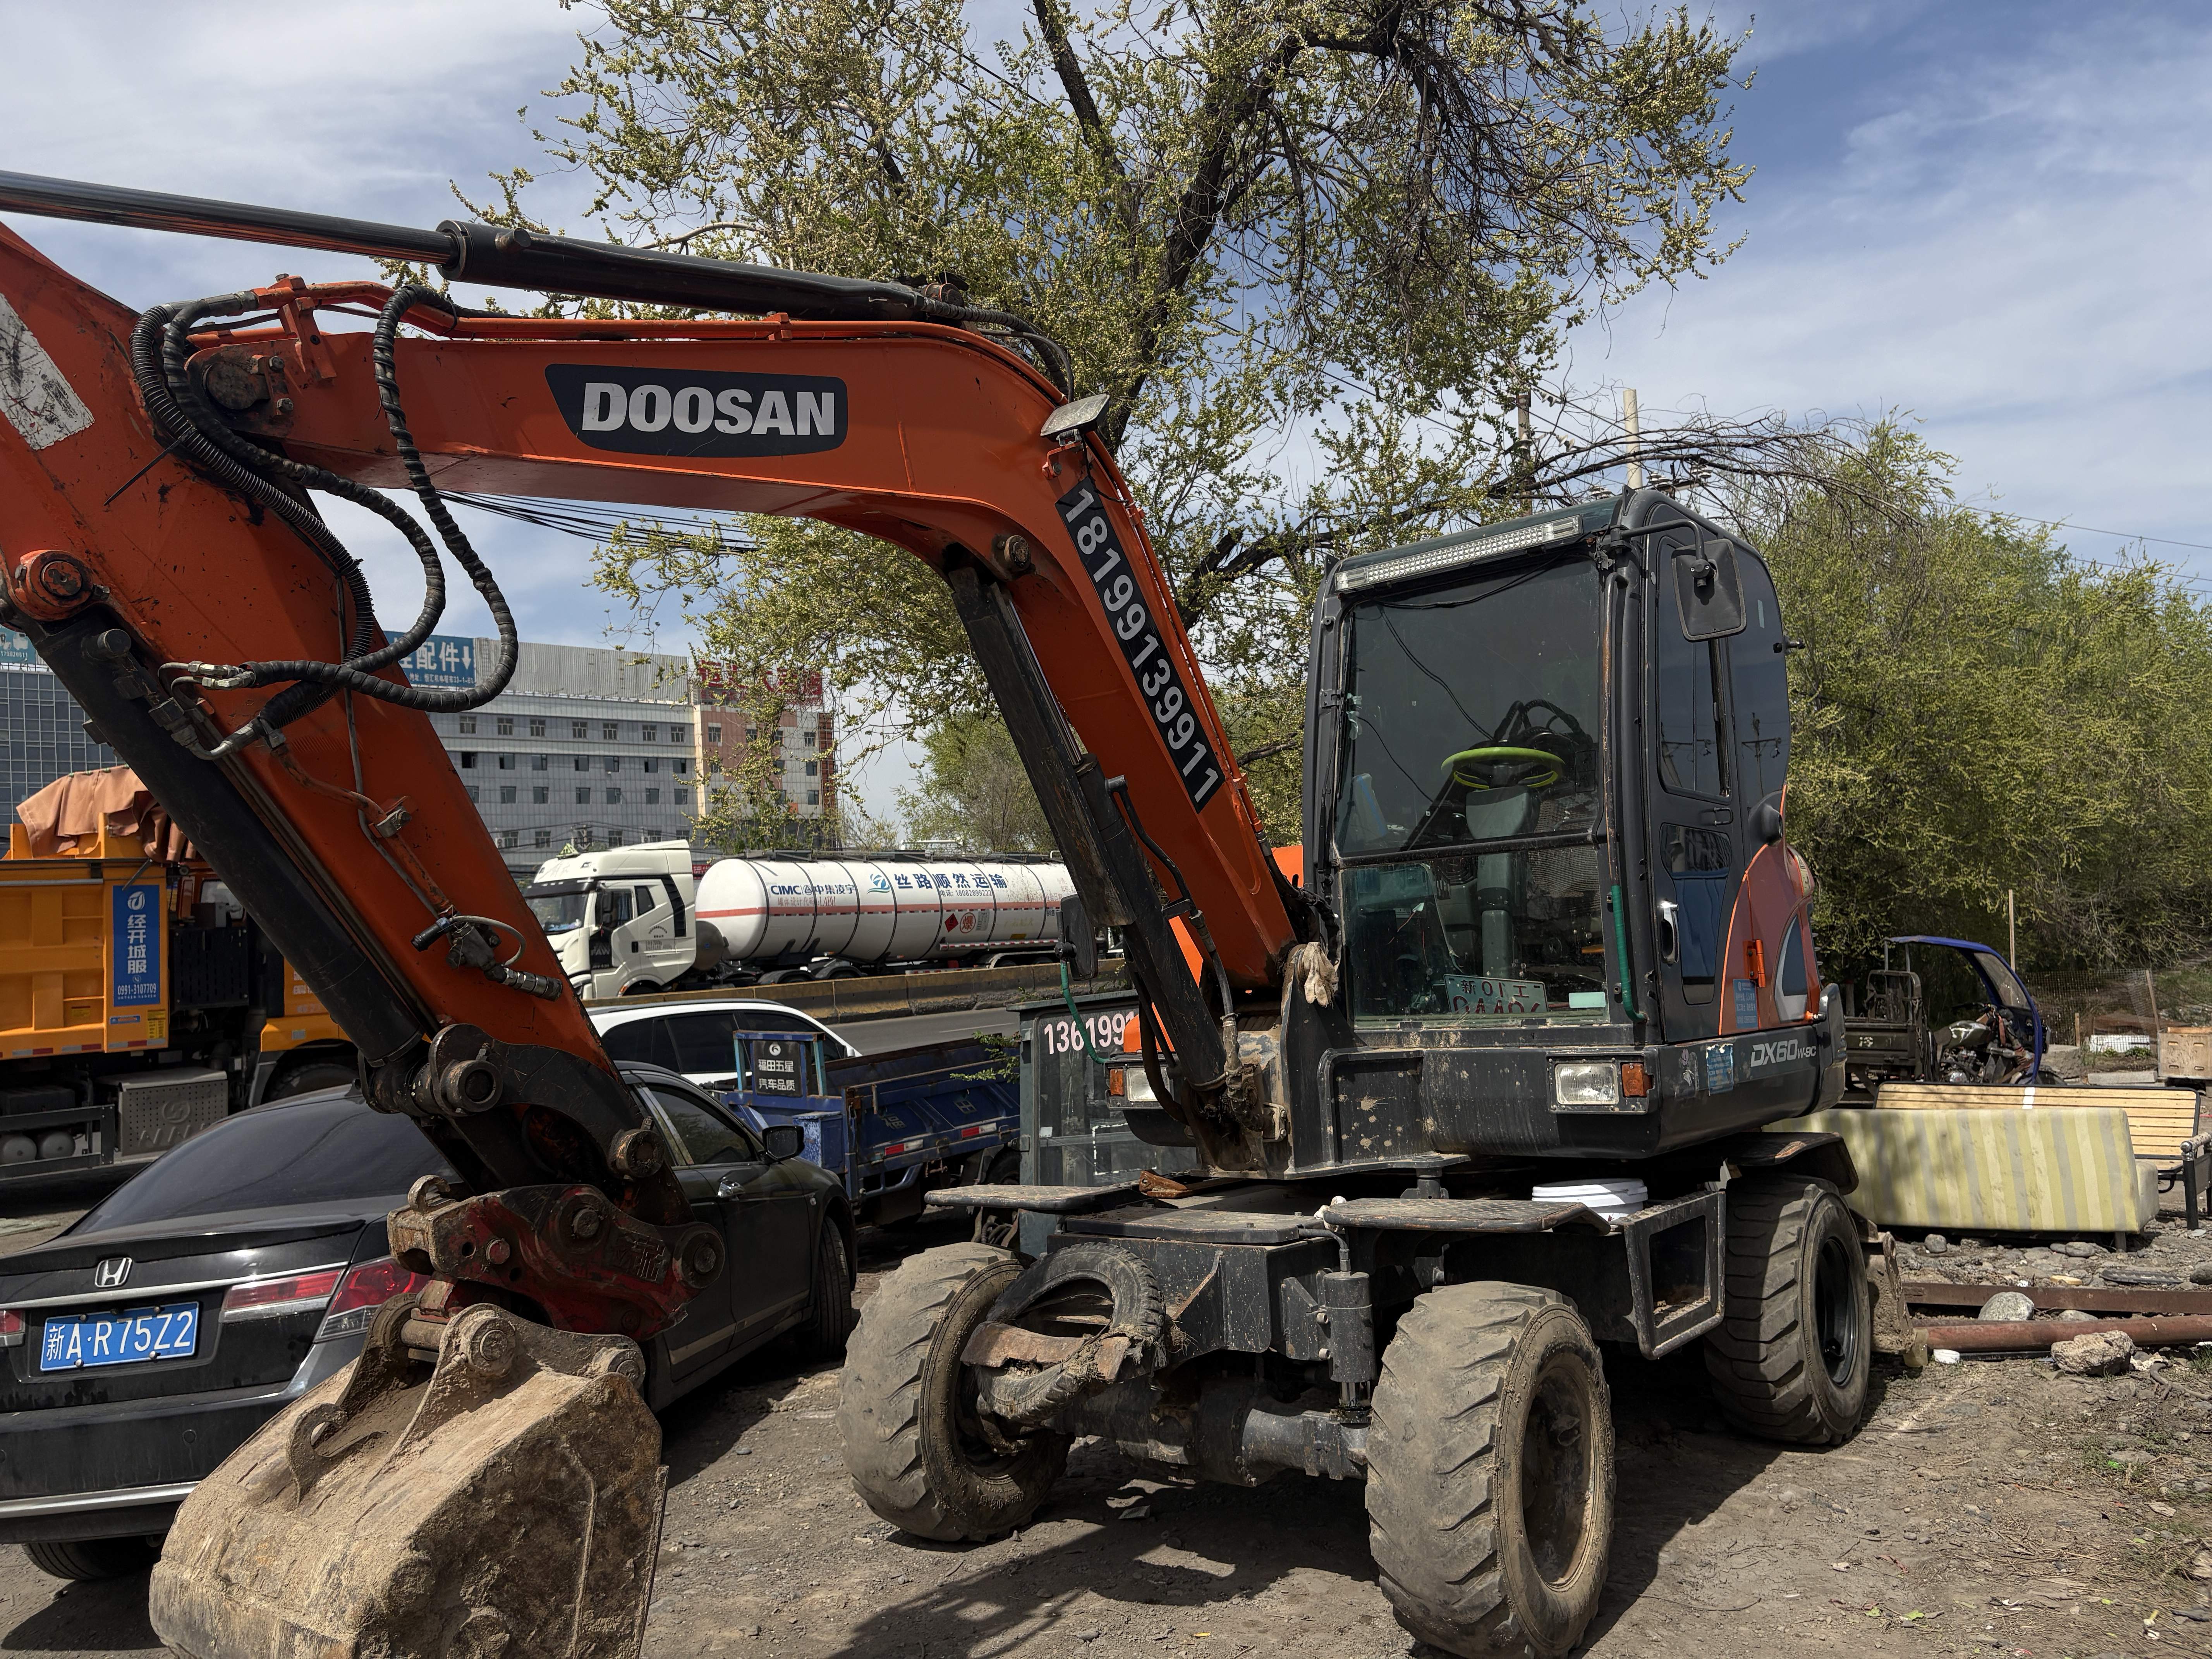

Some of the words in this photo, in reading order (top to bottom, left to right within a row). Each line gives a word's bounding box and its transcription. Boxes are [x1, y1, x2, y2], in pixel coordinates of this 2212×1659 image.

[582, 383, 835, 435] DOOSAN
[1066, 488, 1219, 803] 18199139911
[392, 637, 460, 672] 配件
[895, 873, 1007, 889] 丝路顺然运输
[771, 885, 802, 895] CIMC
[814, 884, 855, 895] 中集凌宇
[962, 916, 973, 930] 爆
[127, 914, 147, 974] 经开城服
[117, 983, 157, 996] 0991-3107709
[758, 1059, 794, 1072] 福田五星
[759, 1078, 795, 1091] 汽车品质
